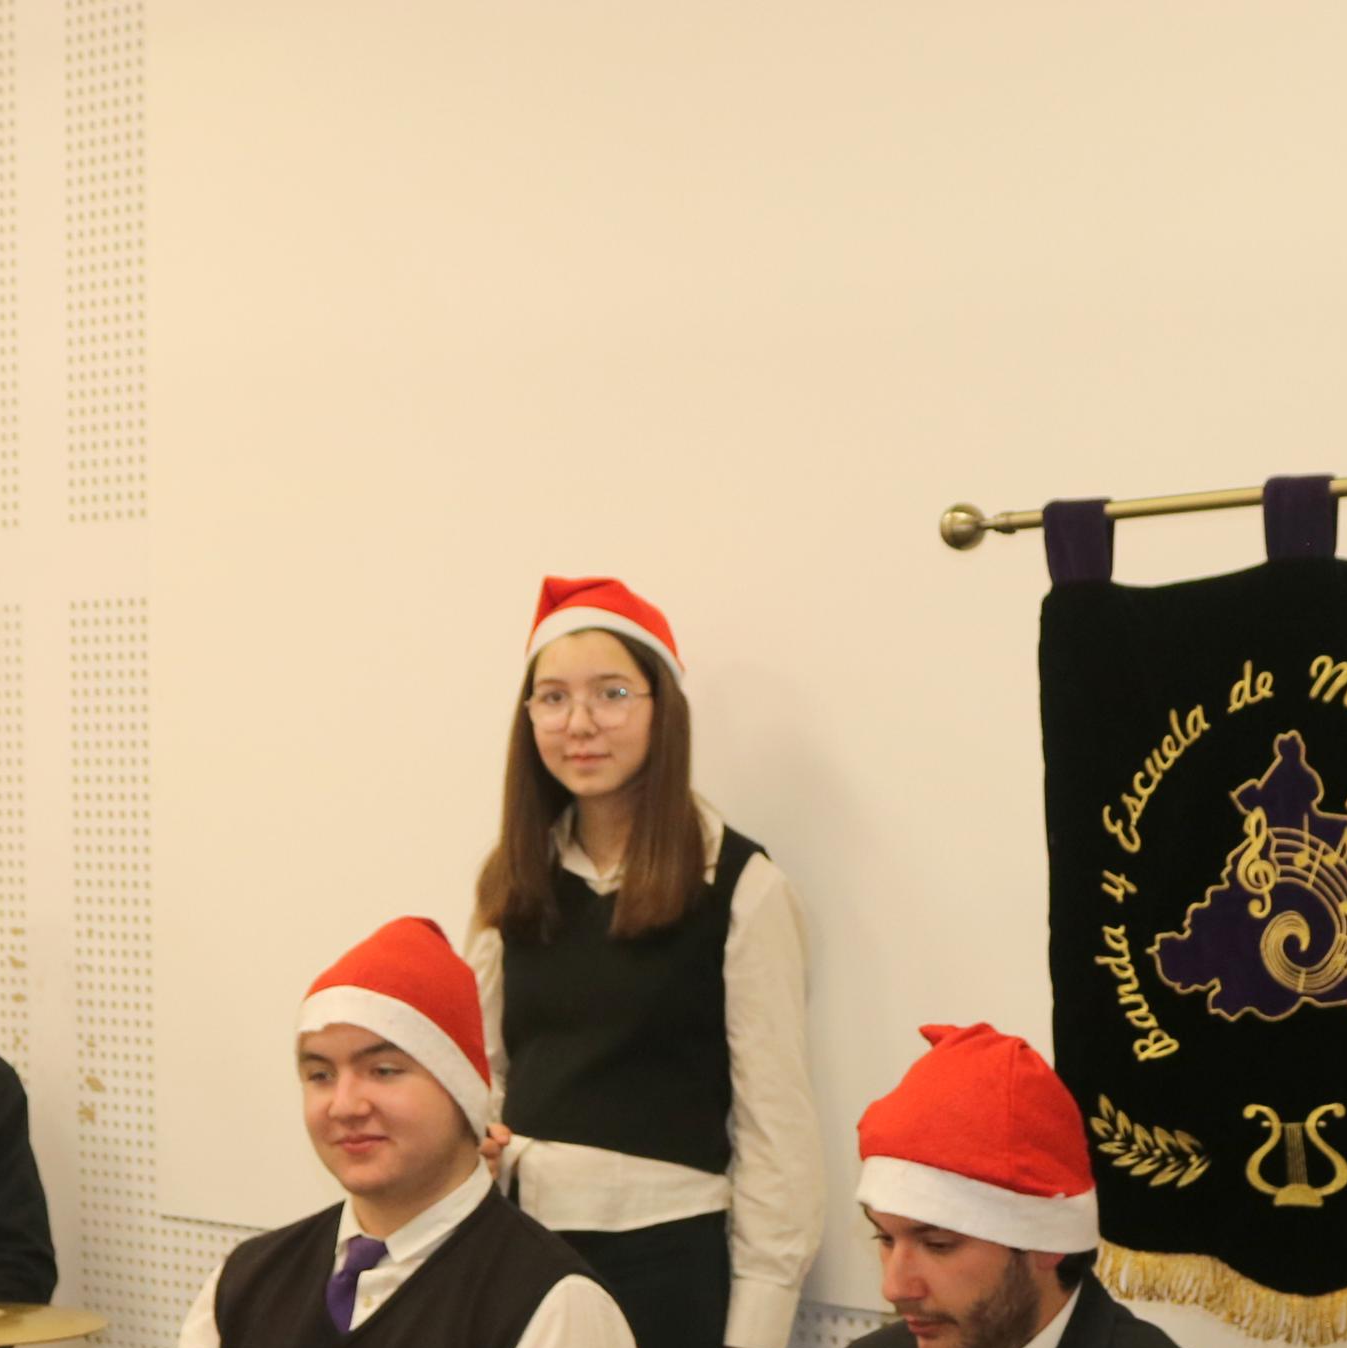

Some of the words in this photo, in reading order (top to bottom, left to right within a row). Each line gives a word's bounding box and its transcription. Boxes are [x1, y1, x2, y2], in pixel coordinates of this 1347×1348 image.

[1227, 660, 1274, 714] de
[1102, 704, 1211, 853] Escuela
[1101, 870, 1137, 902] y
[1095, 921, 1180, 1063] Banda
